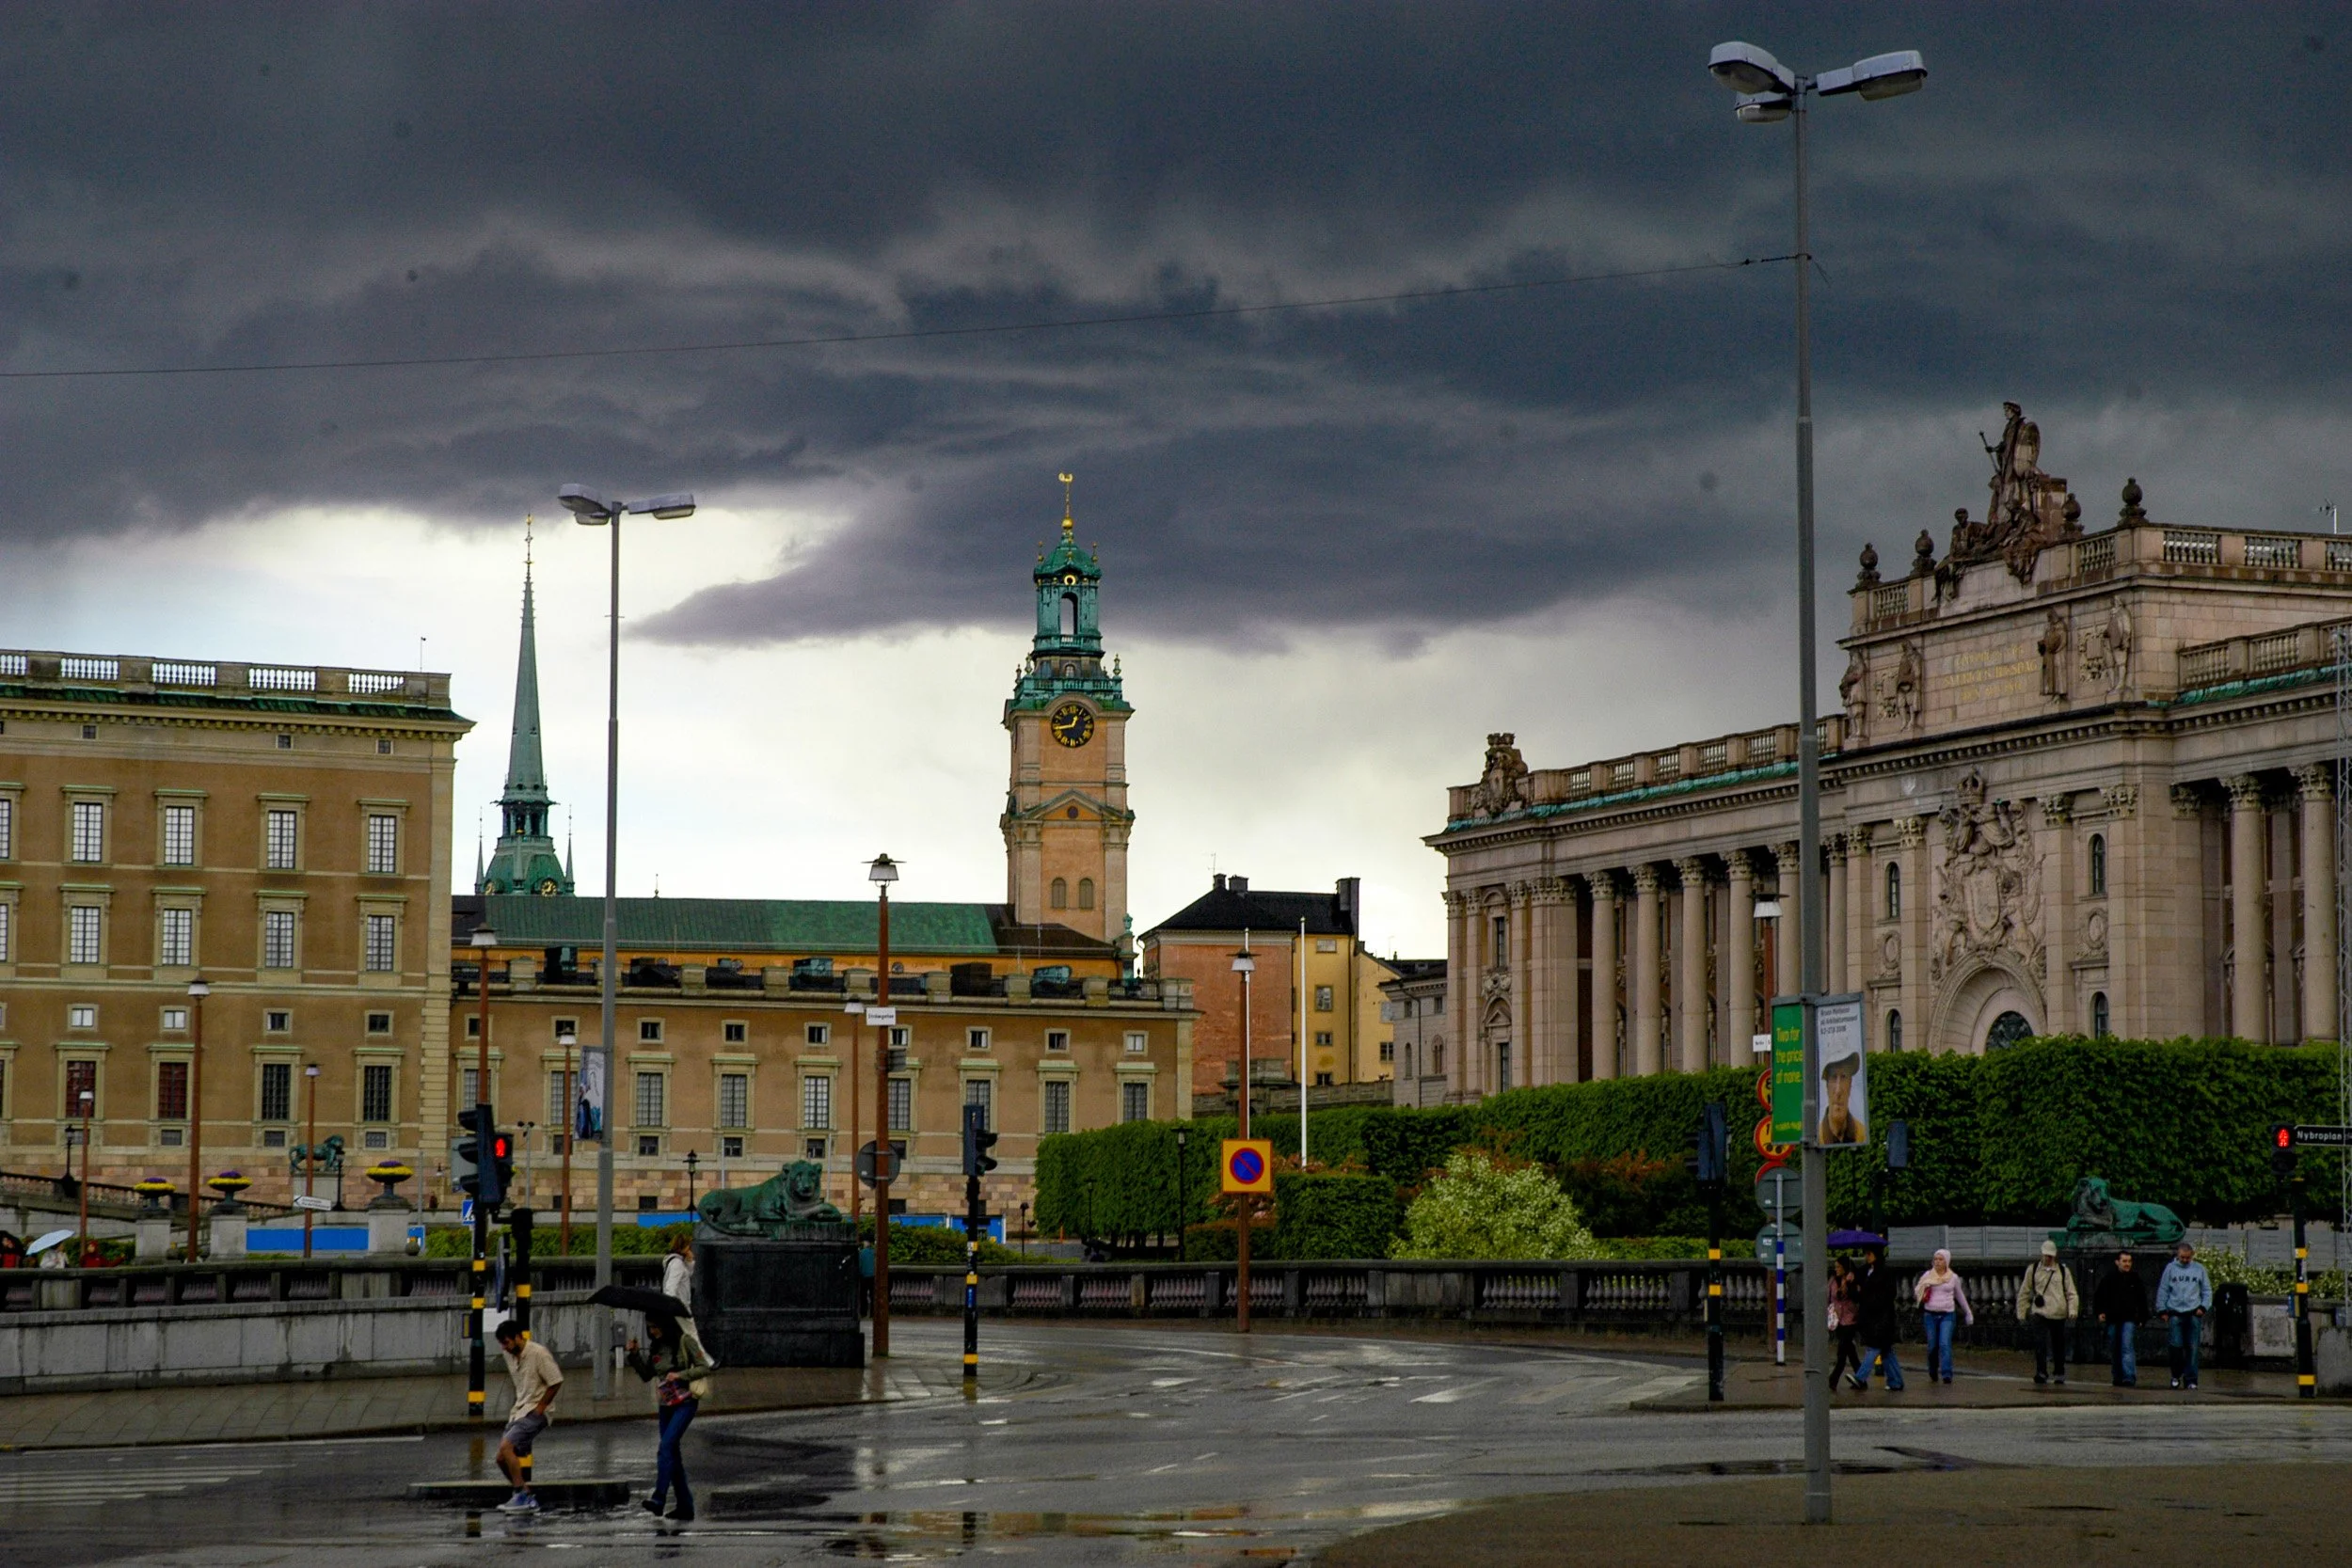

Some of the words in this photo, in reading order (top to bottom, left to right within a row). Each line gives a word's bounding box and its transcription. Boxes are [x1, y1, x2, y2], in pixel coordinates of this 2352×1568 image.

[1775, 1049, 1786, 1064] the
[1787, 1049, 1804, 1066] price
[2296, 1130, 2343, 1142] Nybroplan
